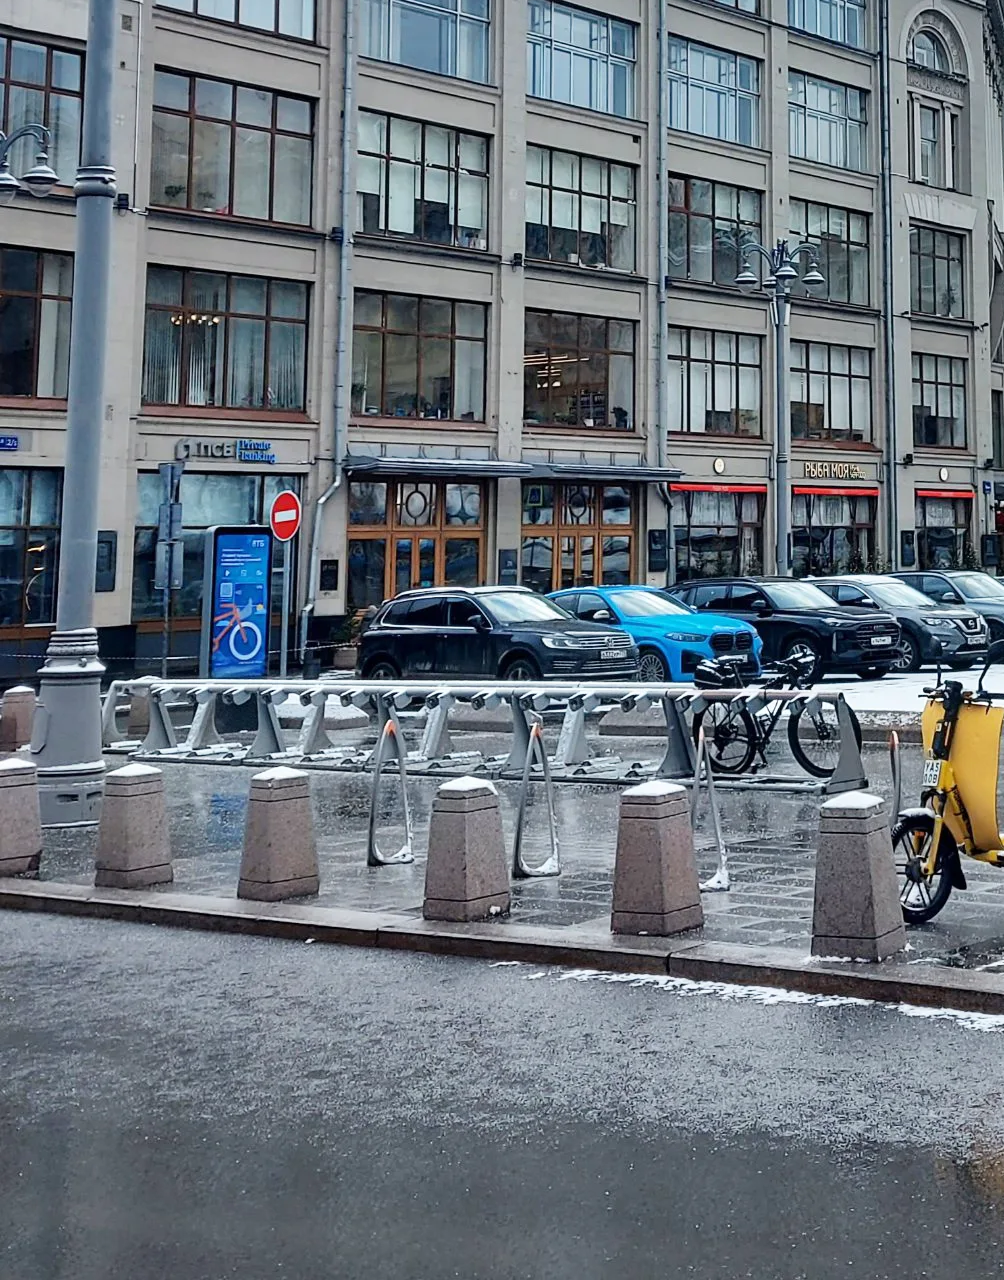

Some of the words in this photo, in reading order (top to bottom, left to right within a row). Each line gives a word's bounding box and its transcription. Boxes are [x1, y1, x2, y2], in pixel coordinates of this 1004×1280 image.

[200, 442, 235, 457] ПСБ
[805, 462, 829, 478] РЫБА
[831, 463, 849, 478] МОЯ
